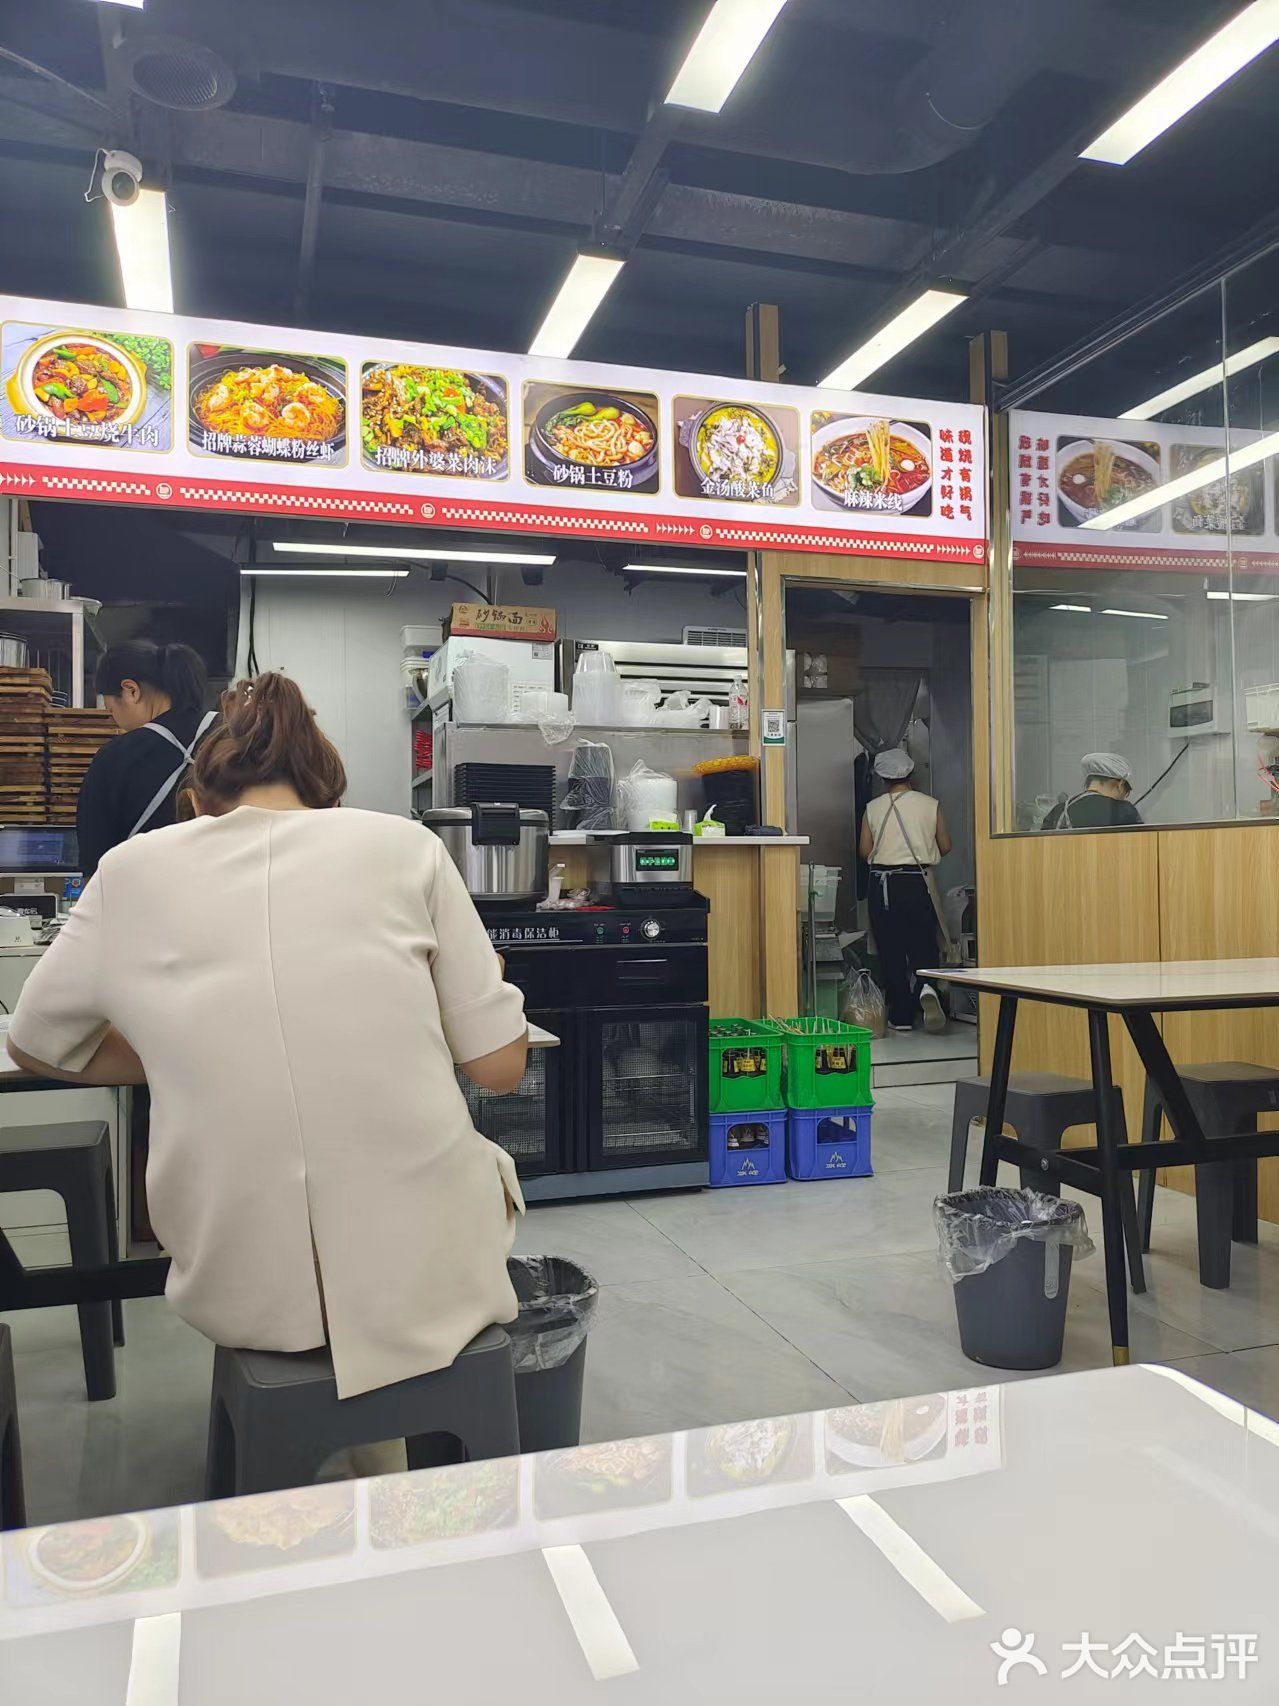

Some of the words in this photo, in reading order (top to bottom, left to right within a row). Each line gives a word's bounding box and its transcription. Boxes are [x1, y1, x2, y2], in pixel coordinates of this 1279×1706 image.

[16, 414, 159, 447] 砂锅土豆烧牛肉
[202, 430, 335, 462] 招牌蒜蓉蝴蝶粉丝虾
[553, 464, 634, 489] 砂锅土豆粉
[939, 428, 954, 519] 味道才好吃
[958, 430, 972, 521] 现烧有锅气
[701, 478, 775, 500] 金汤酸菜鱼
[843, 489, 903, 511] 麻辣米线
[476, 608, 523, 625] 砂锅面
